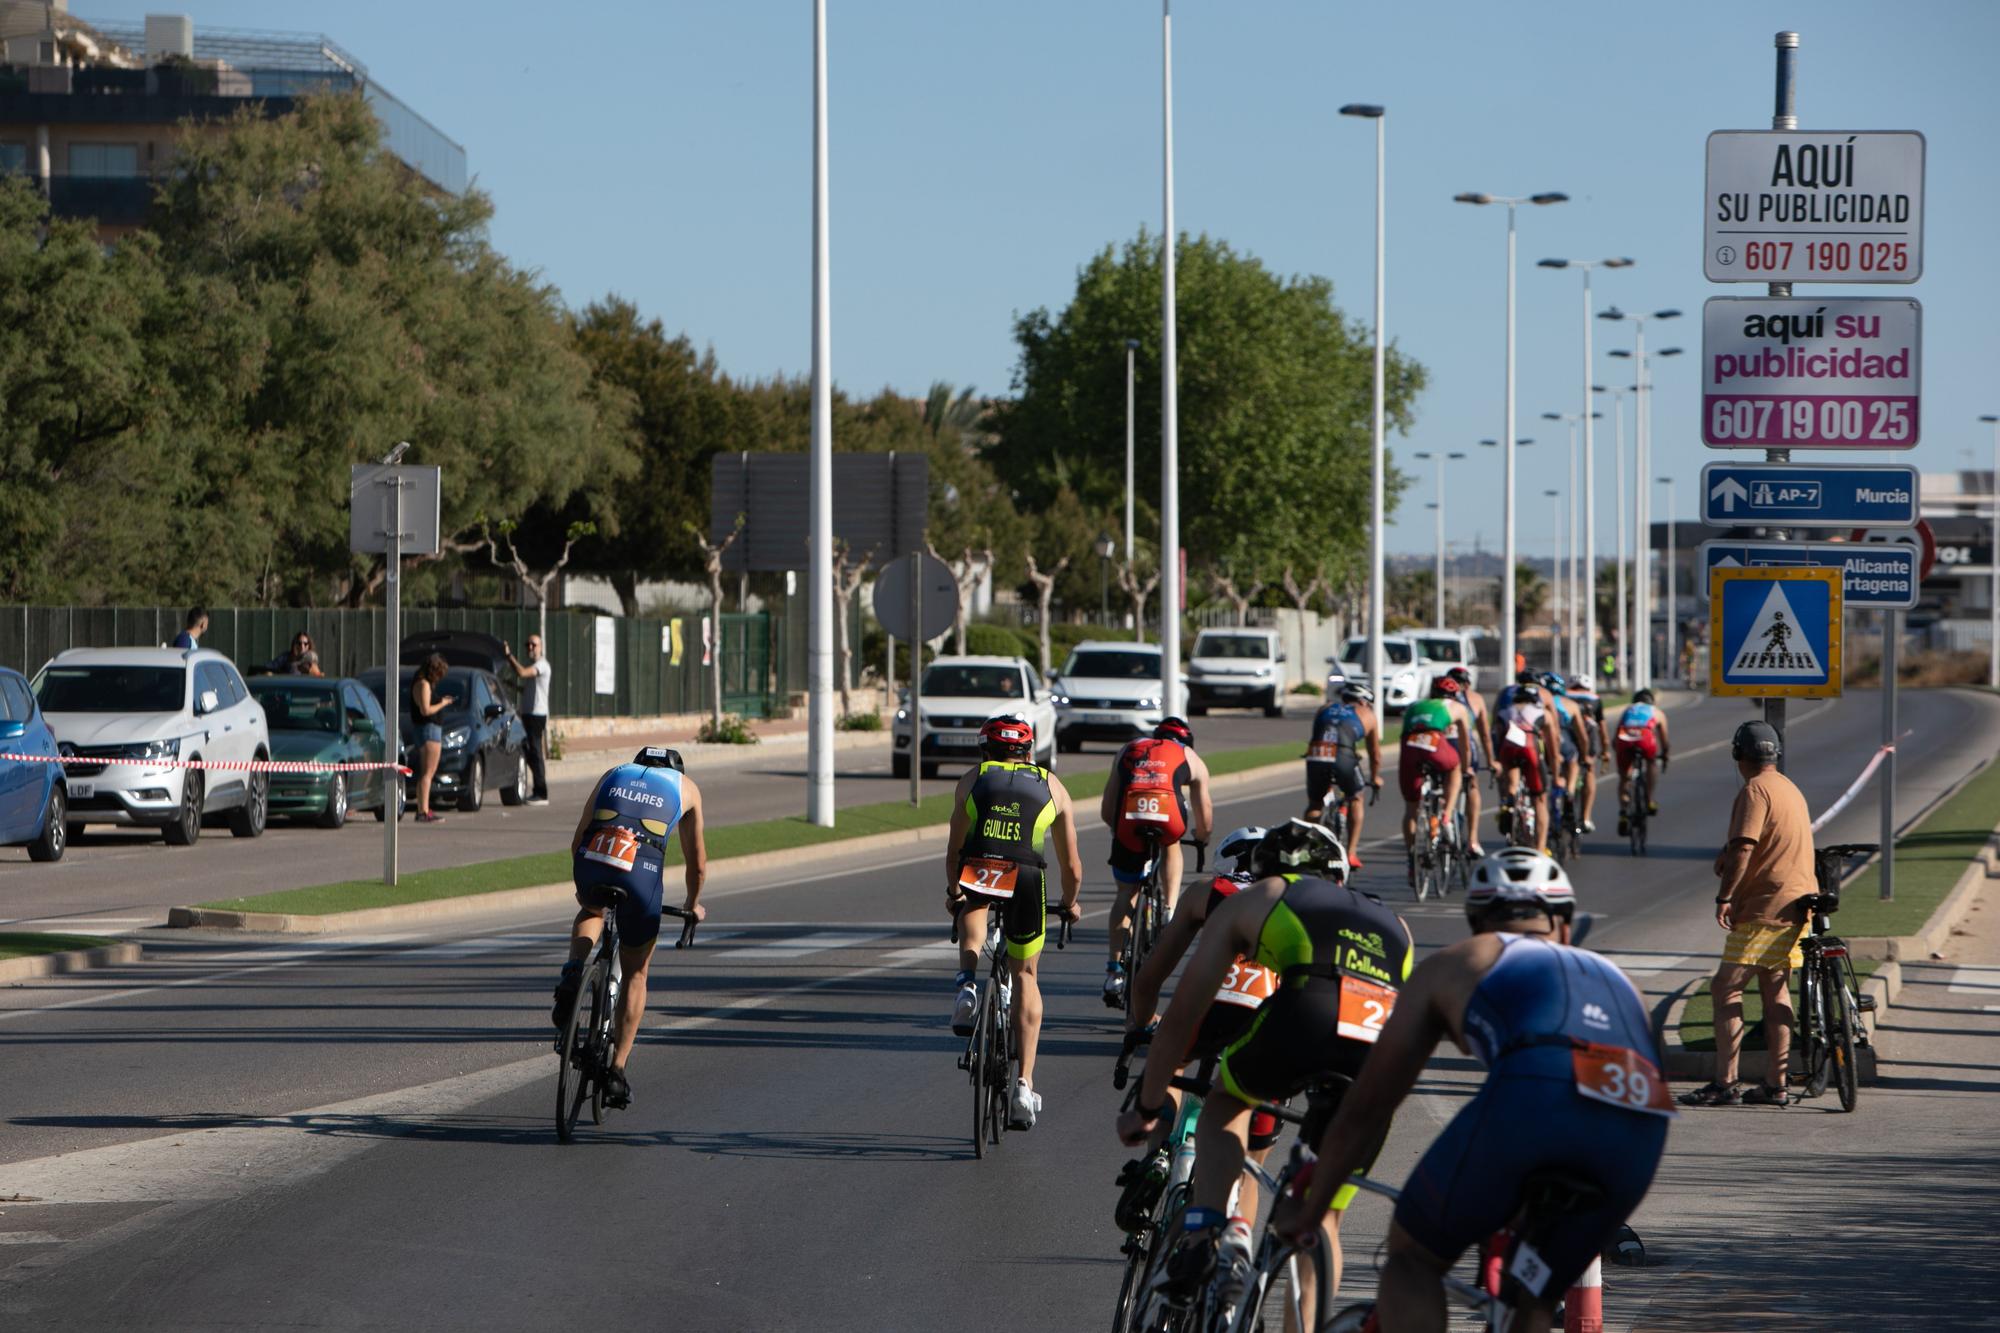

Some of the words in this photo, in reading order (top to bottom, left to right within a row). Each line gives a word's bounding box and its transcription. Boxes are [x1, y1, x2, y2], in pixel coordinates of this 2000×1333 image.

[1771, 136, 1857, 189] AQUÍ
[1717, 193, 1749, 222] SU
[1759, 194, 1910, 223] PUBLICIDAD
[1745, 242, 1794, 270] 607
[1806, 242, 1850, 271] 190
[1859, 243, 1907, 271] 025
[1744, 307, 1827, 344] aquí
[1835, 315, 1880, 338] su
[1714, 347, 1908, 384] publicidad
[1820, 401, 1863, 440] 00
[1869, 402, 1909, 440] 25
[1778, 489, 1817, 501] AP-7
[1856, 488, 1909, 503] Murcia
[1844, 559, 1909, 574] Alicante
[1844, 578, 1909, 594] rtagena
[609, 787, 664, 808] PALLARES
[1137, 797, 1160, 813] 96
[983, 818, 1013, 840] GUILLE
[596, 834, 633, 858] 117
[974, 868, 1004, 888] 27
[1601, 1063, 1650, 1107] 39
